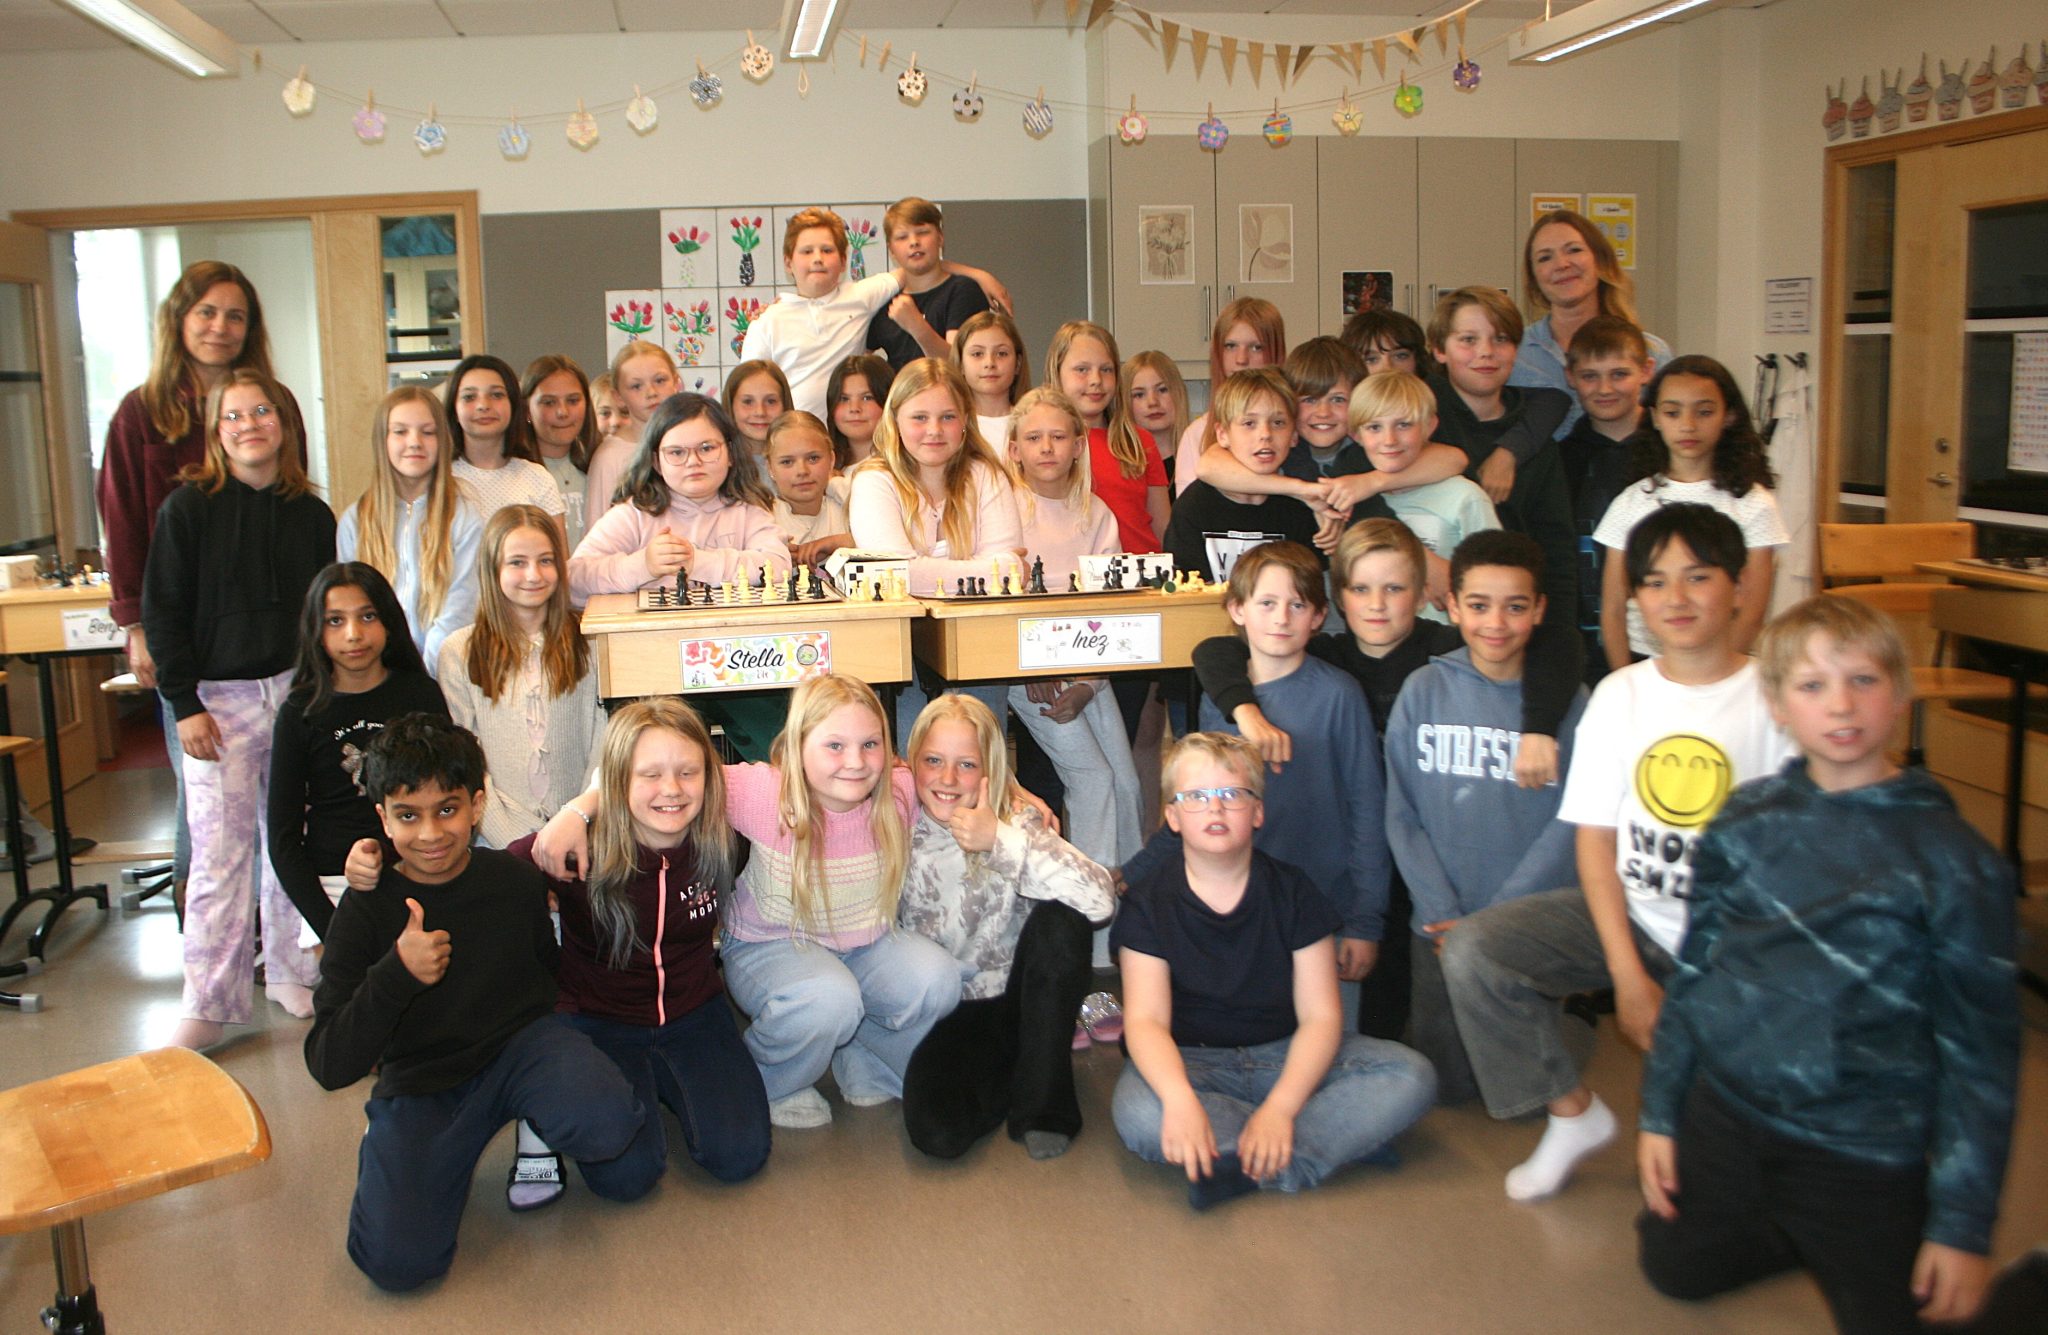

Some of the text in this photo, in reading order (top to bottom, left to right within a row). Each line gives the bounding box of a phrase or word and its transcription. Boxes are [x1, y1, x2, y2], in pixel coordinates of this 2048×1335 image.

[1072, 629, 1109, 656] Inez
[727, 647, 785, 670] Stella
[366, 722, 385, 731] goo
[1417, 723, 1552, 785] SURFSI
